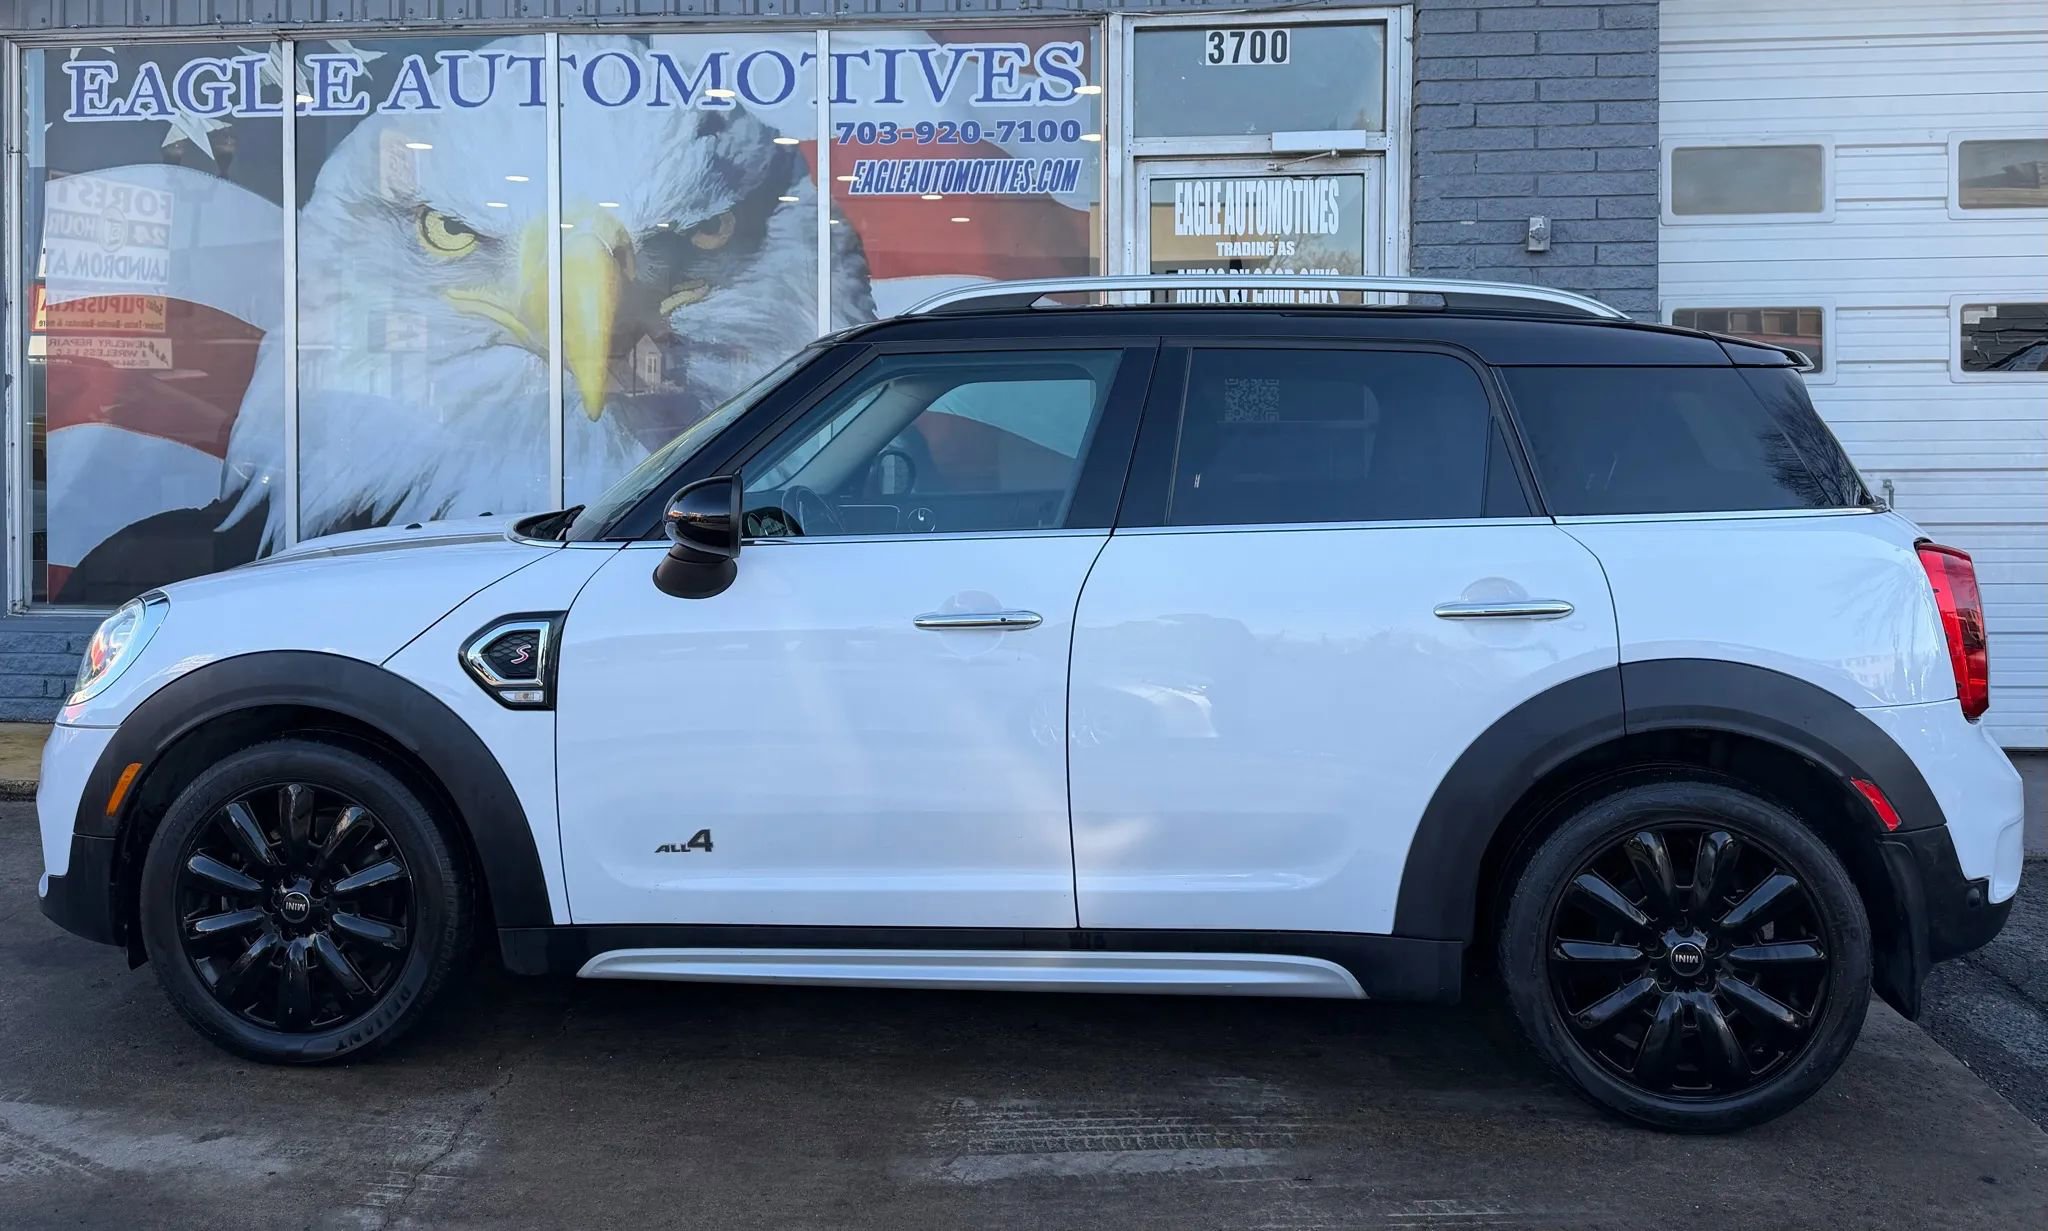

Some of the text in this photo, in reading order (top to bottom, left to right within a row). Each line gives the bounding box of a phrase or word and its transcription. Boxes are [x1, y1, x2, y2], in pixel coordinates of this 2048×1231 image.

[1208, 30, 1288, 64] 3700
[64, 42, 1085, 121] EAGLE AUTOMOTIVES
[836, 119, 1082, 145] 703-920-7100
[849, 157, 1083, 194] EAGLEAUTOMOTIVES.COM
[1174, 179, 1340, 236] EAGLE AUTOMOTIVES
[1216, 241, 1296, 257] TRADING AS
[511, 644, 531, 664] S
[285, 901, 305, 911] MINI
[1675, 954, 1699, 963] MINI
